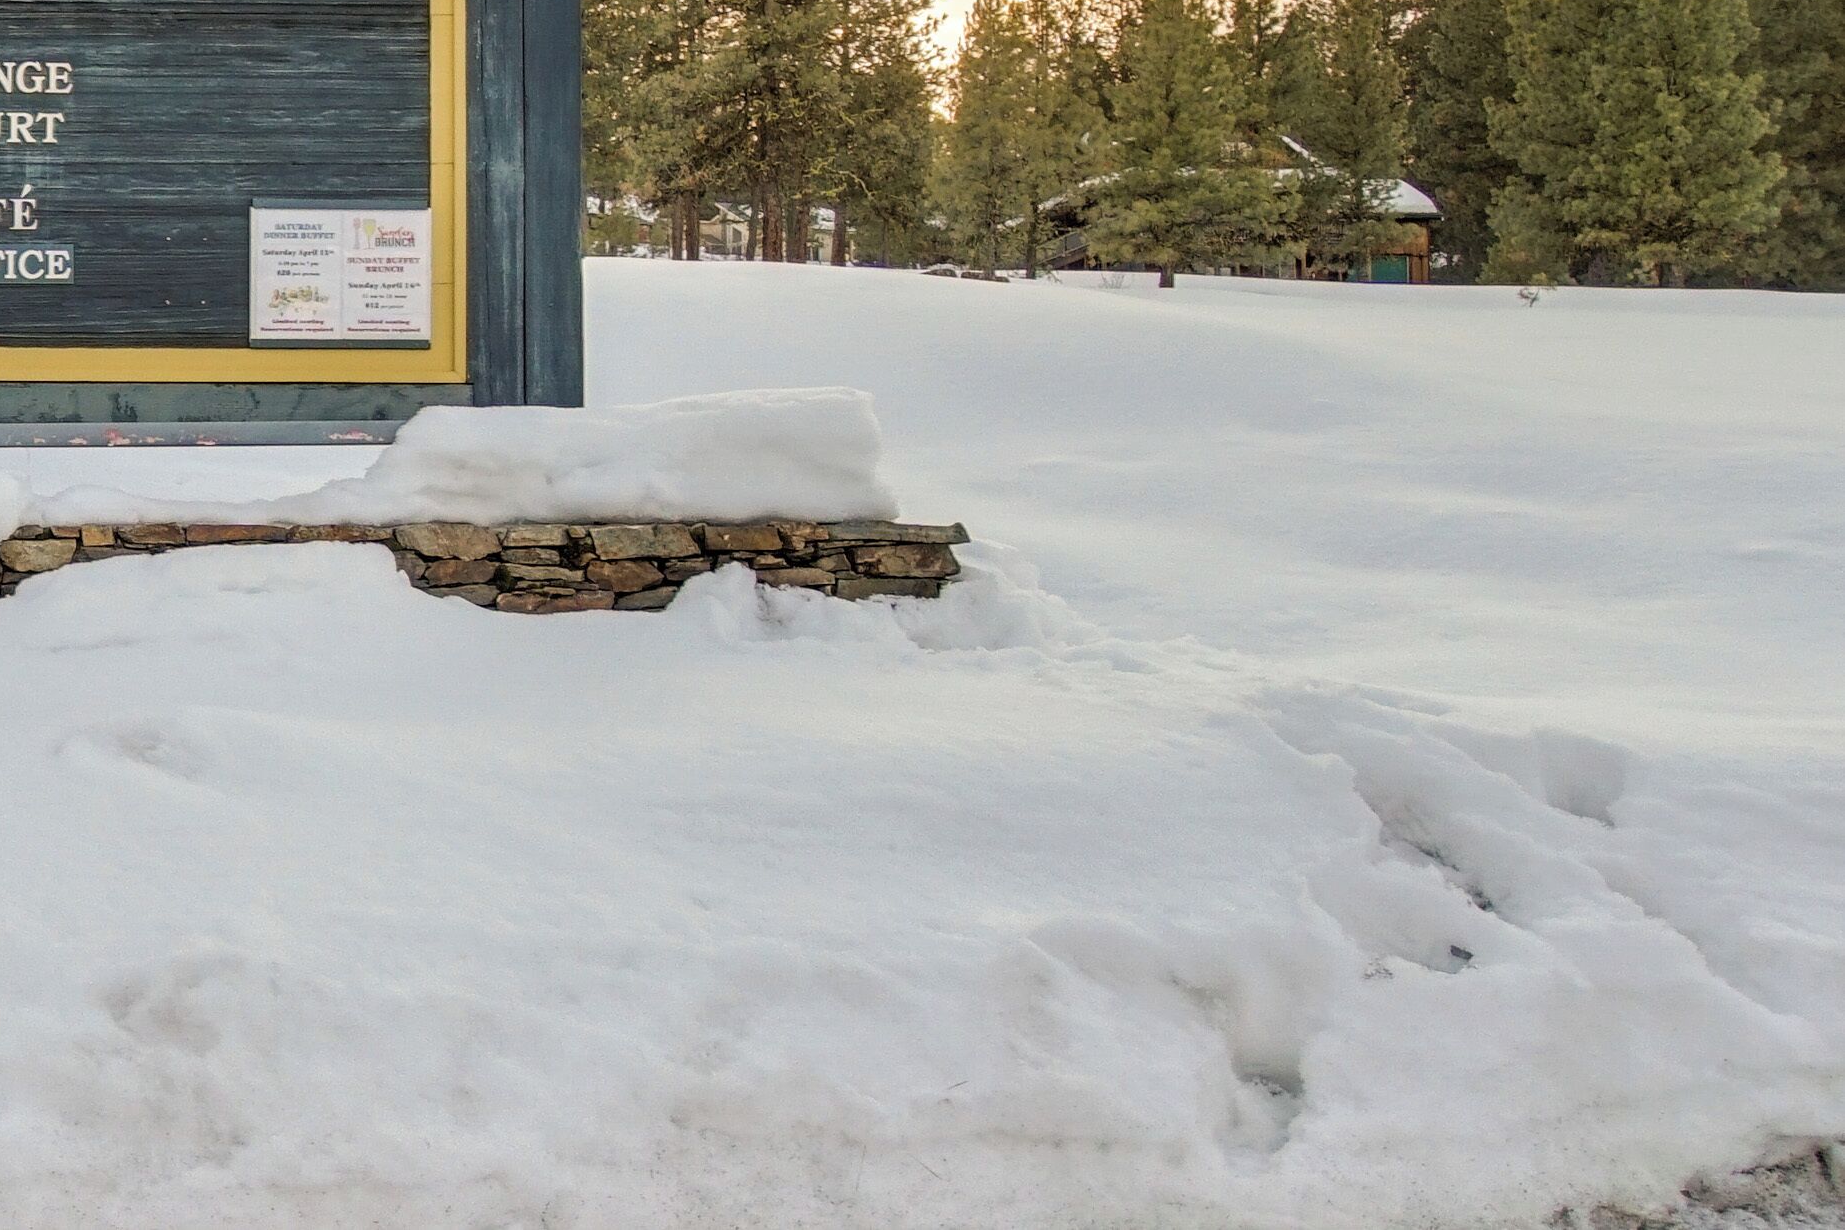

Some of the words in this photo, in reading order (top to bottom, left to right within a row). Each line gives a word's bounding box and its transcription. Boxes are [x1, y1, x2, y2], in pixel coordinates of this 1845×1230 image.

[274, 222, 324, 231] SATURDAY
[263, 231, 299, 240] DINNER
[300, 231, 336, 240] BUFFET
[374, 236, 415, 248] BRUNCH
[261, 249, 296, 258] Saturday
[346, 256, 384, 265] SUNDAY
[385, 256, 421, 265] BUFFET
[364, 265, 405, 273] BRUNCH
[348, 282, 379, 290] Sunday
